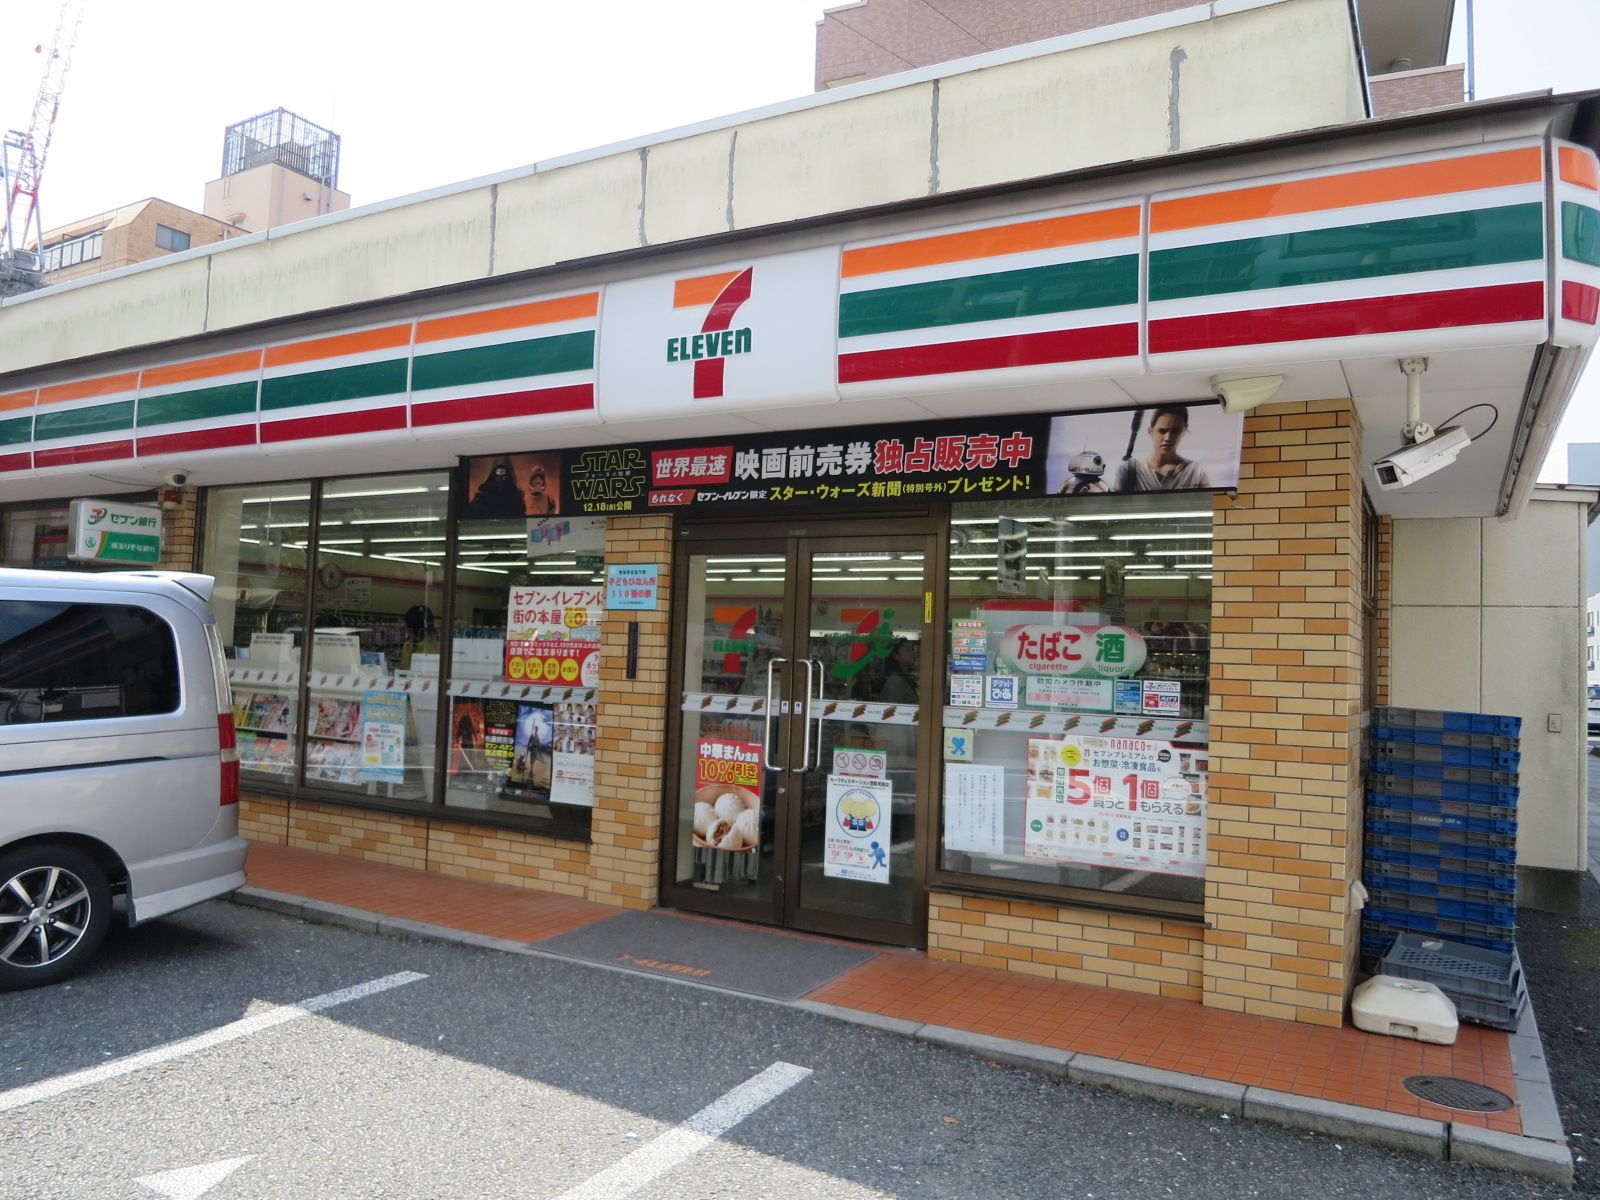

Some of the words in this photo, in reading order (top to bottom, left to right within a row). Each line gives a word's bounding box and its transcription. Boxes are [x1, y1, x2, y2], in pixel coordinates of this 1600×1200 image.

[673, 266, 753, 399] 7
[571, 449, 646, 473] STAR
[656, 455, 728, 480] 世界最速
[571, 476, 646, 500] WARS
[652, 492, 684, 504] もれなく
[111, 513, 157, 528] セブン銀行
[513, 609, 562, 625] 街の本屋
[1017, 632, 1082, 661] たばこ
[1095, 633, 1126, 662] 酒
[1029, 663, 1069, 671] cigarette
[1098, 664, 1126, 673] liquor
[1036, 677, 1102, 687] 防犯カメラ作動中
[1140, 800, 1184, 816] もらえる
